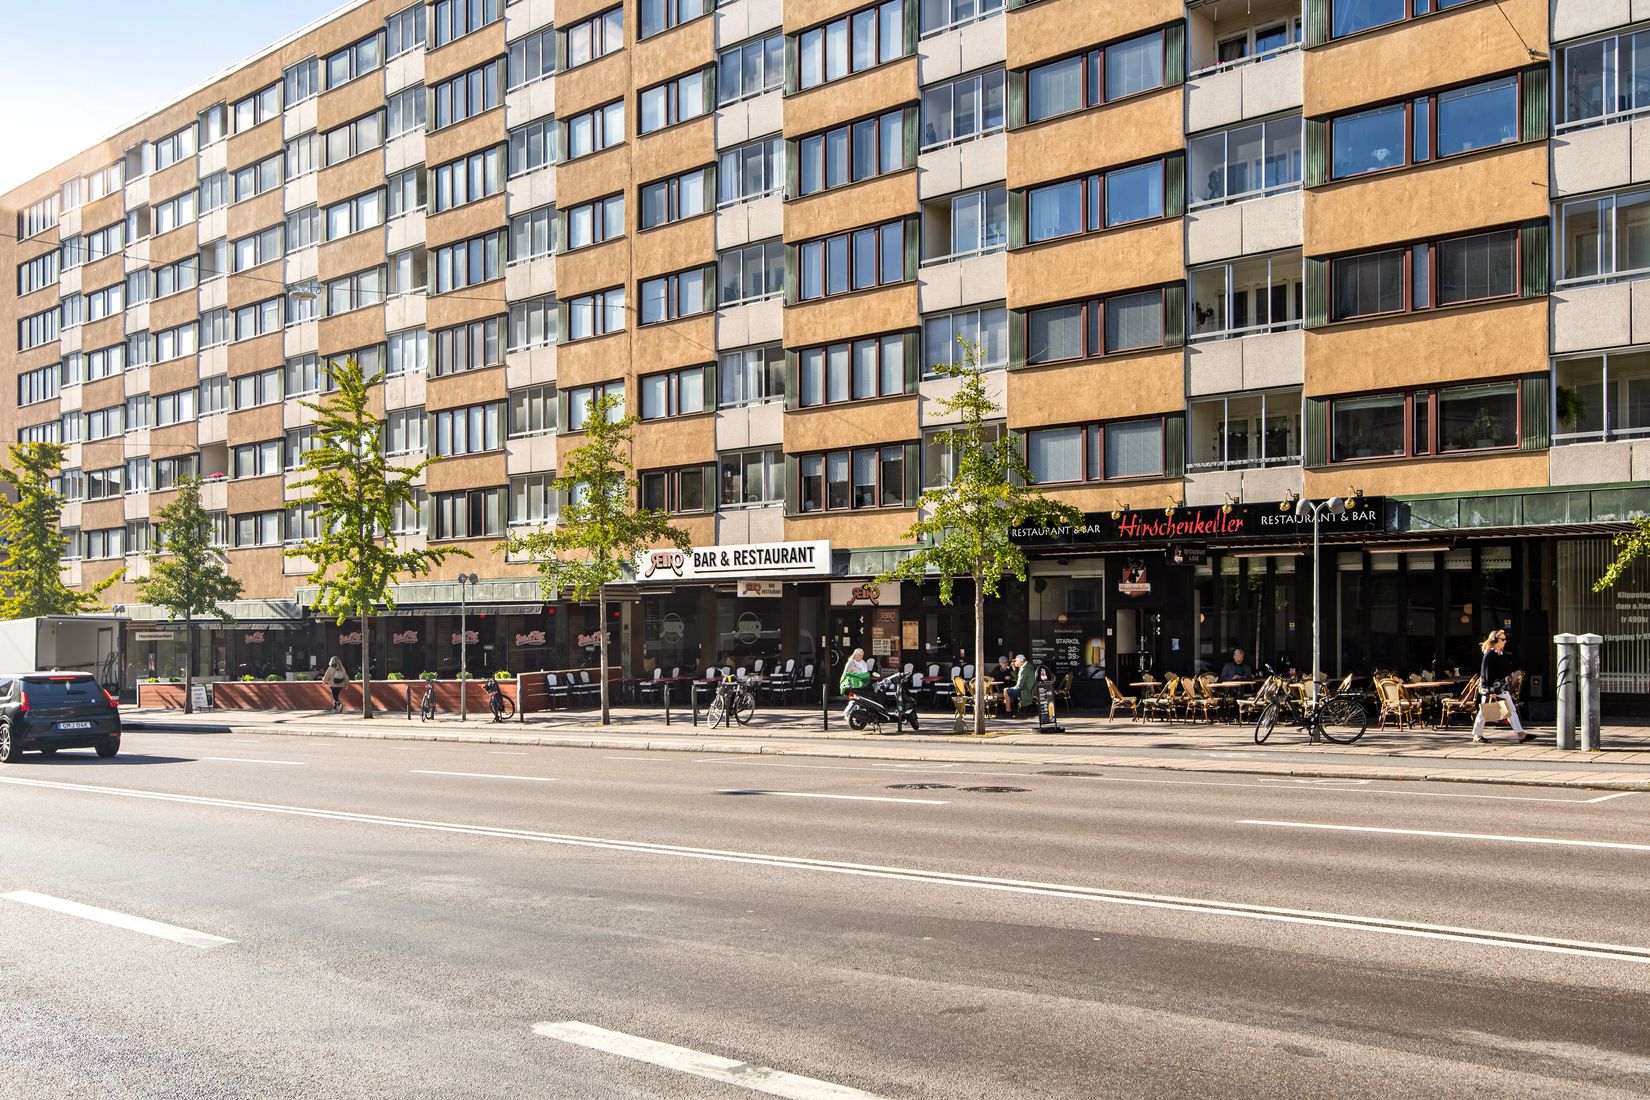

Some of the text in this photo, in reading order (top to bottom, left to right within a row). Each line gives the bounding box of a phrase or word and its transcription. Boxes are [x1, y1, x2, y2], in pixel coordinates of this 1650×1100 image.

[1118, 509, 1244, 539] Hirschenkeller
[1341, 512, 1349, 522] &
[1353, 510, 1376, 521] BAR
[1012, 526, 1070, 538] RESTAURANT
[693, 546, 816, 568] BAR & RESTAURANT
